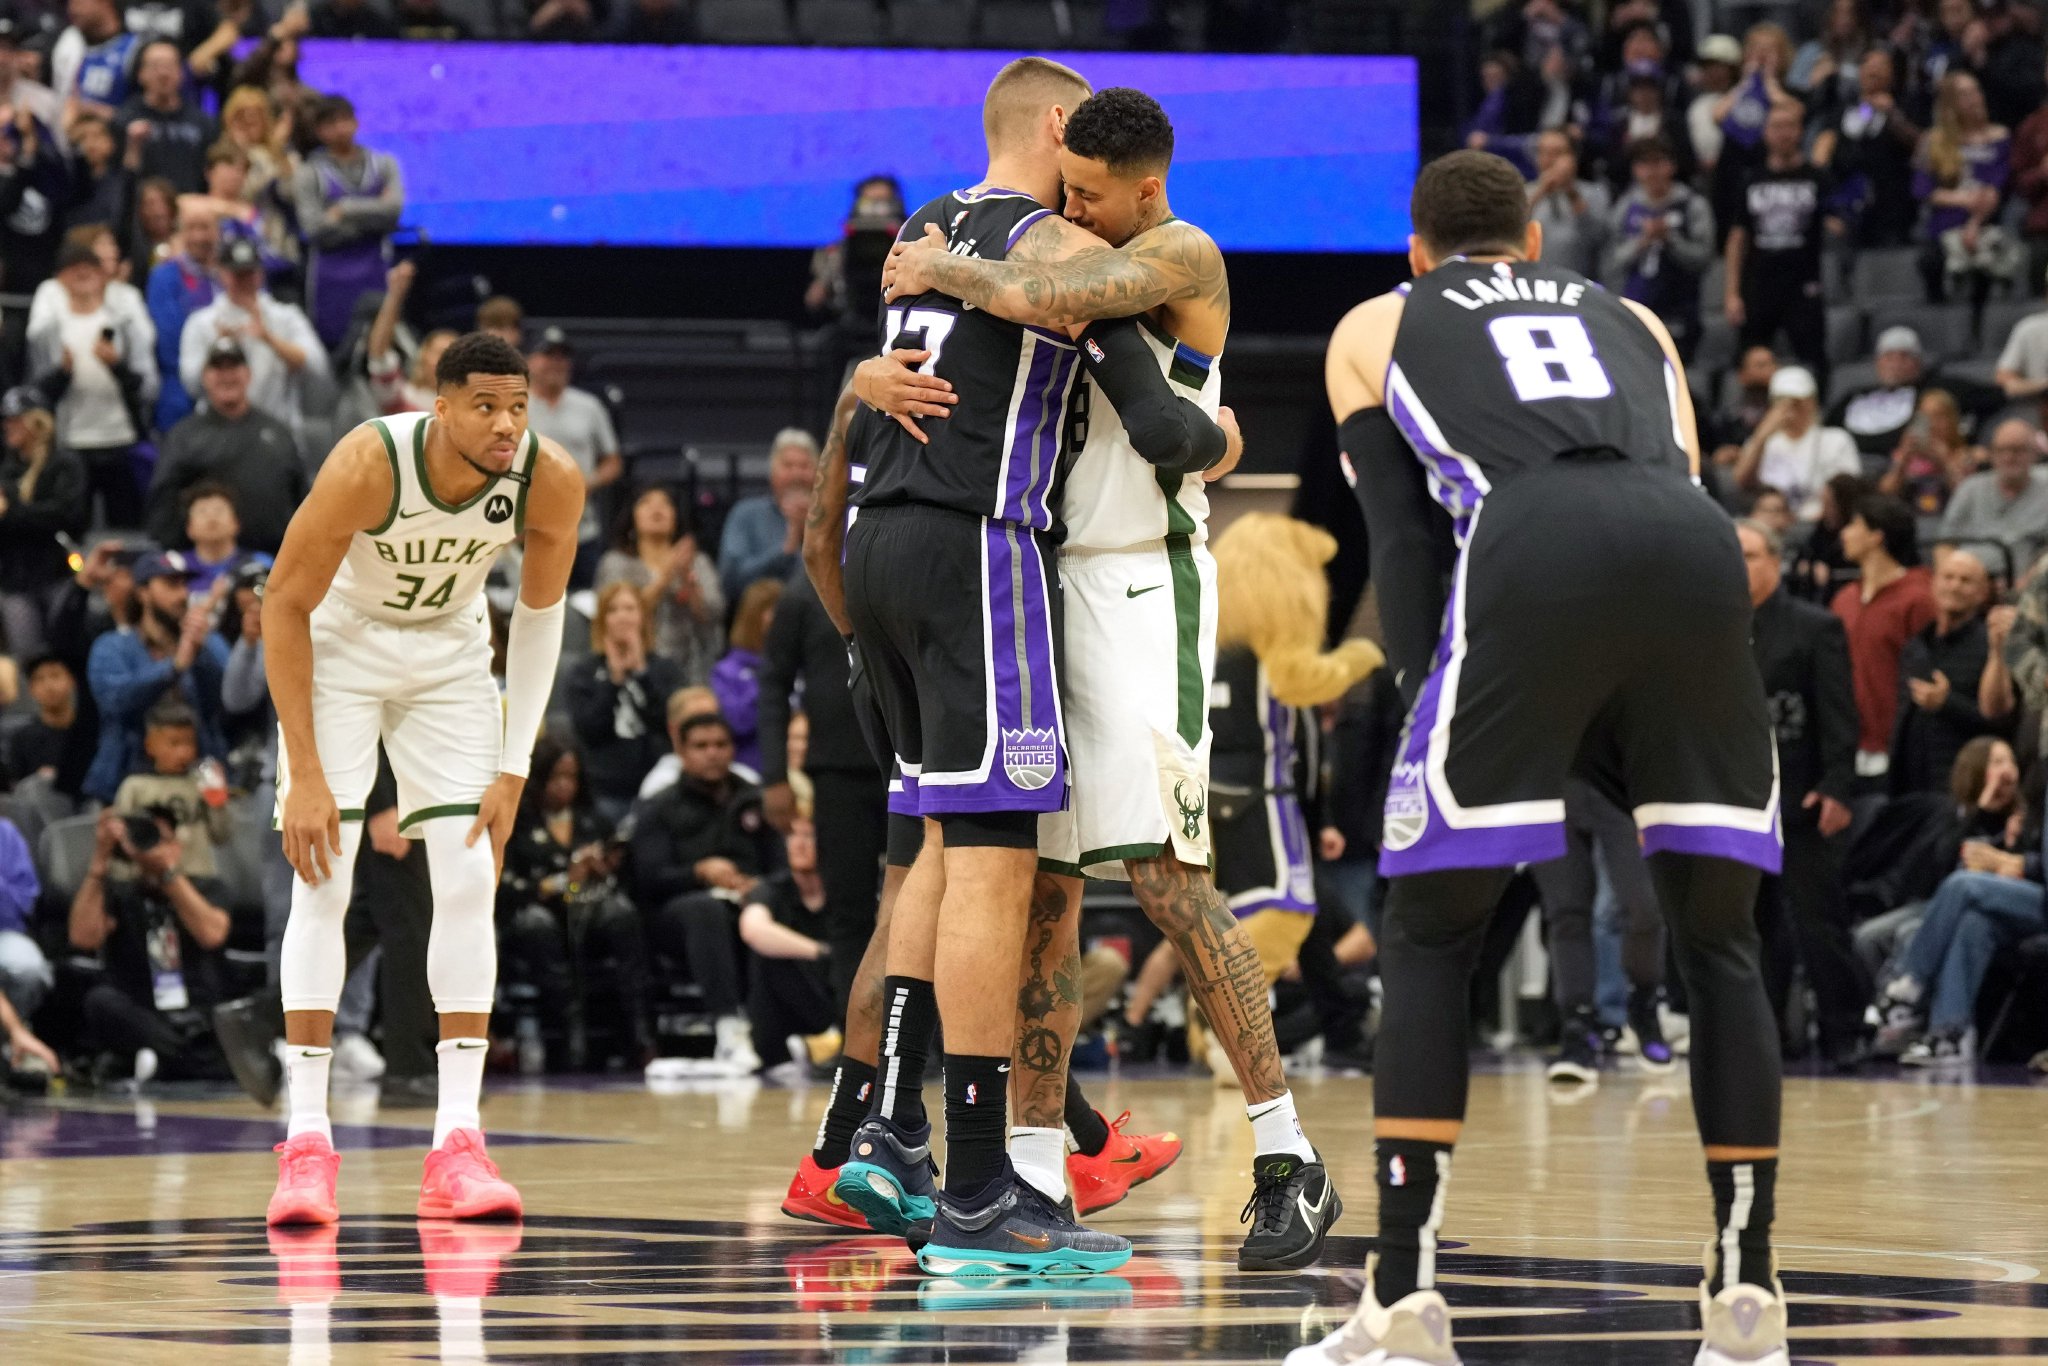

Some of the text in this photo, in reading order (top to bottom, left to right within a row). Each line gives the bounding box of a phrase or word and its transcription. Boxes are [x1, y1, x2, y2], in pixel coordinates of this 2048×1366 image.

[1441, 277, 1586, 311] LAVINE
[1485, 314, 1614, 402] 8
[382, 573, 457, 611] 34
[1005, 753, 1055, 766] KINGS
